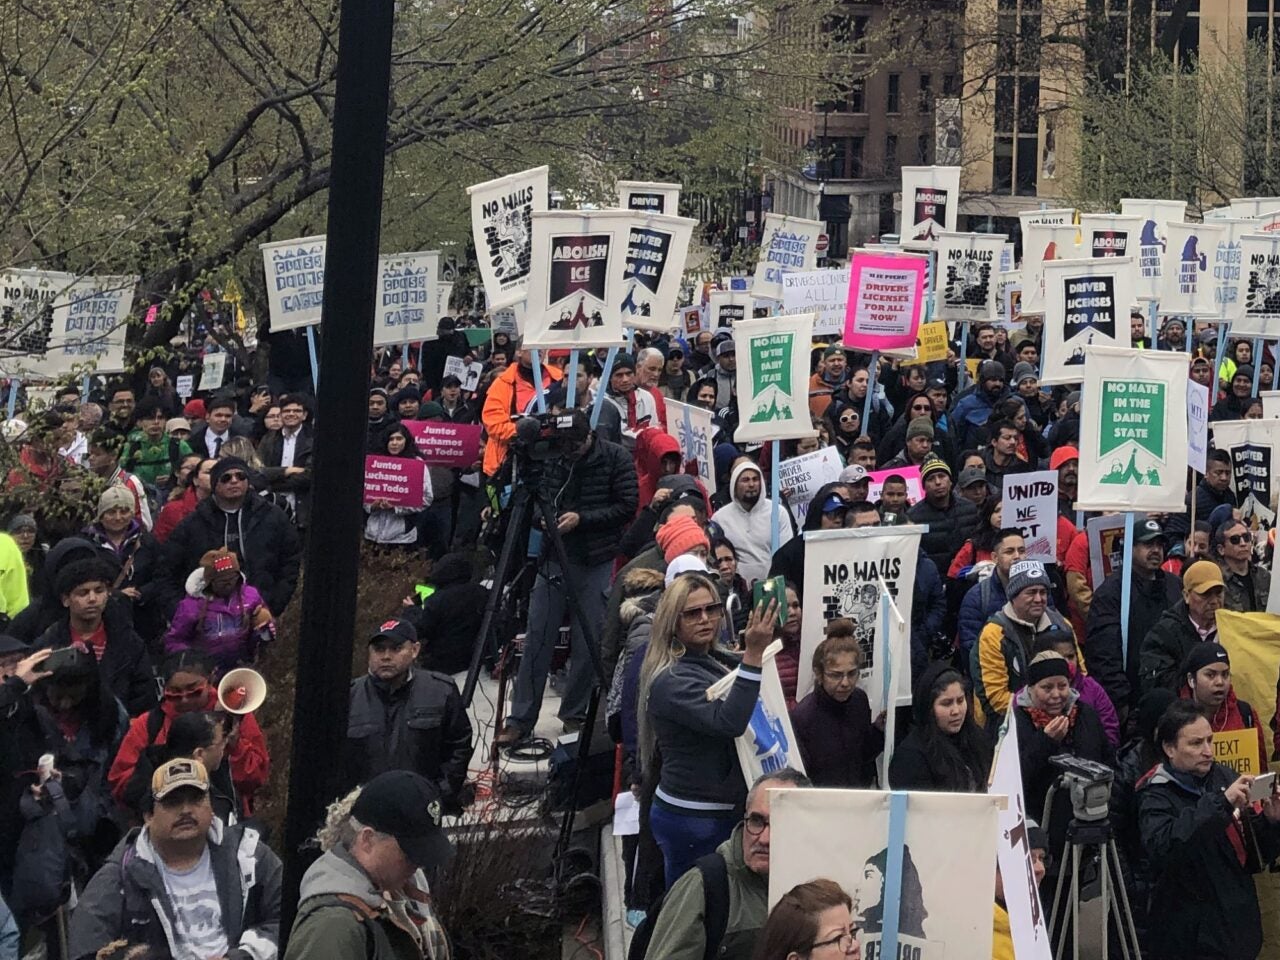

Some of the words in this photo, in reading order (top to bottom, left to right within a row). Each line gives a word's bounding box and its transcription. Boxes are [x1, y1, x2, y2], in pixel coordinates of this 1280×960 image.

[482, 199, 499, 220] NO
[502, 185, 534, 211] WALLS
[631, 197, 659, 207] DRIVER
[916, 193, 946, 204] ABOLISH
[925, 205, 936, 215] ICE
[629, 233, 663, 248] RIVER
[1093, 238, 1126, 248] ABOLISH
[552, 244, 609, 260] ABOLISH
[627, 248, 663, 262] CENSES
[948, 249, 962, 260] NO
[965, 249, 994, 261] WALLS
[1250, 253, 1265, 266] NO
[570, 265, 591, 281] ICE
[638, 265, 657, 277] ALL
[865, 283, 908, 293] DRIVERS
[1069, 281, 1107, 294] DRIVER
[862, 293, 909, 302] LICENSES
[1067, 297, 1112, 309] LICENSES
[864, 303, 885, 312] FOR
[887, 304, 905, 312] ALL
[1066, 313, 1089, 325] FOR
[1091, 312, 1112, 323] ALL
[923, 327, 937, 335] TEXT
[754, 337, 769, 347] NO
[771, 334, 788, 345] HATE
[1108, 382, 1127, 393] NO
[1128, 382, 1159, 395] HATE
[1114, 398, 1128, 408] IN
[1130, 398, 1151, 409] THE
[1113, 413, 1152, 424] DAIRY
[423, 426, 456, 436] Juntos
[1114, 427, 1148, 439] STATE
[415, 436, 463, 447] Luchamos
[1235, 450, 1264, 463] DRIVER
[371, 460, 402, 471] Juntos
[779, 464, 802, 479] DRIVER
[1235, 466, 1268, 477] LICENSES
[365, 471, 408, 483] Luchamos
[780, 472, 812, 489] LICENSES
[382, 484, 409, 494] Todos
[1008, 482, 1055, 500] UNITED
[1252, 481, 1267, 492] ALL
[1016, 505, 1038, 519] WE
[1022, 524, 1041, 538] CT
[823, 564, 848, 585] NO
[853, 557, 902, 582] WALLS
[1213, 739, 1240, 756] TEXT
